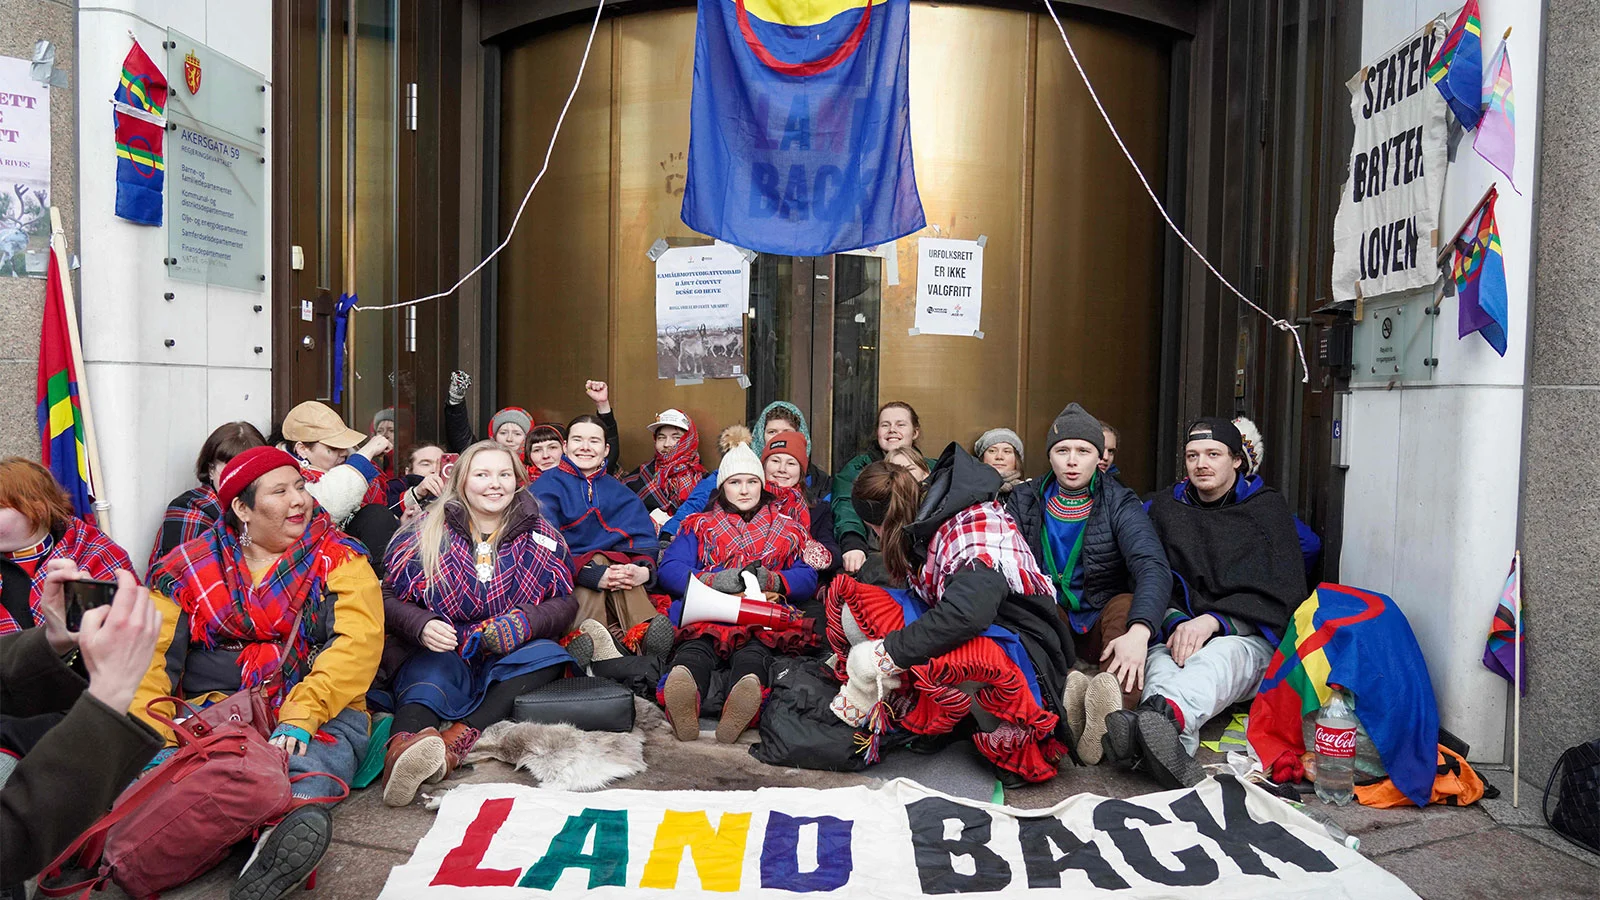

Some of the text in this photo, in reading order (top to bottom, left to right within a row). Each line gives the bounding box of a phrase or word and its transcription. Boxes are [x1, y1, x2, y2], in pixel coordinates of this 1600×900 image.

[1362, 28, 1436, 120] STATEN
[181, 129, 240, 160] AKERSGATA 59
[4, 159, 30, 168] RIVES!
[928, 249, 973, 261] URFOLKSRETT
[1360, 215, 1419, 281] LOVEN
[934, 266, 966, 278] ER IKKE
[928, 284, 972, 298] VALGFRITT
[428, 774, 1338, 894] LAND BACK
